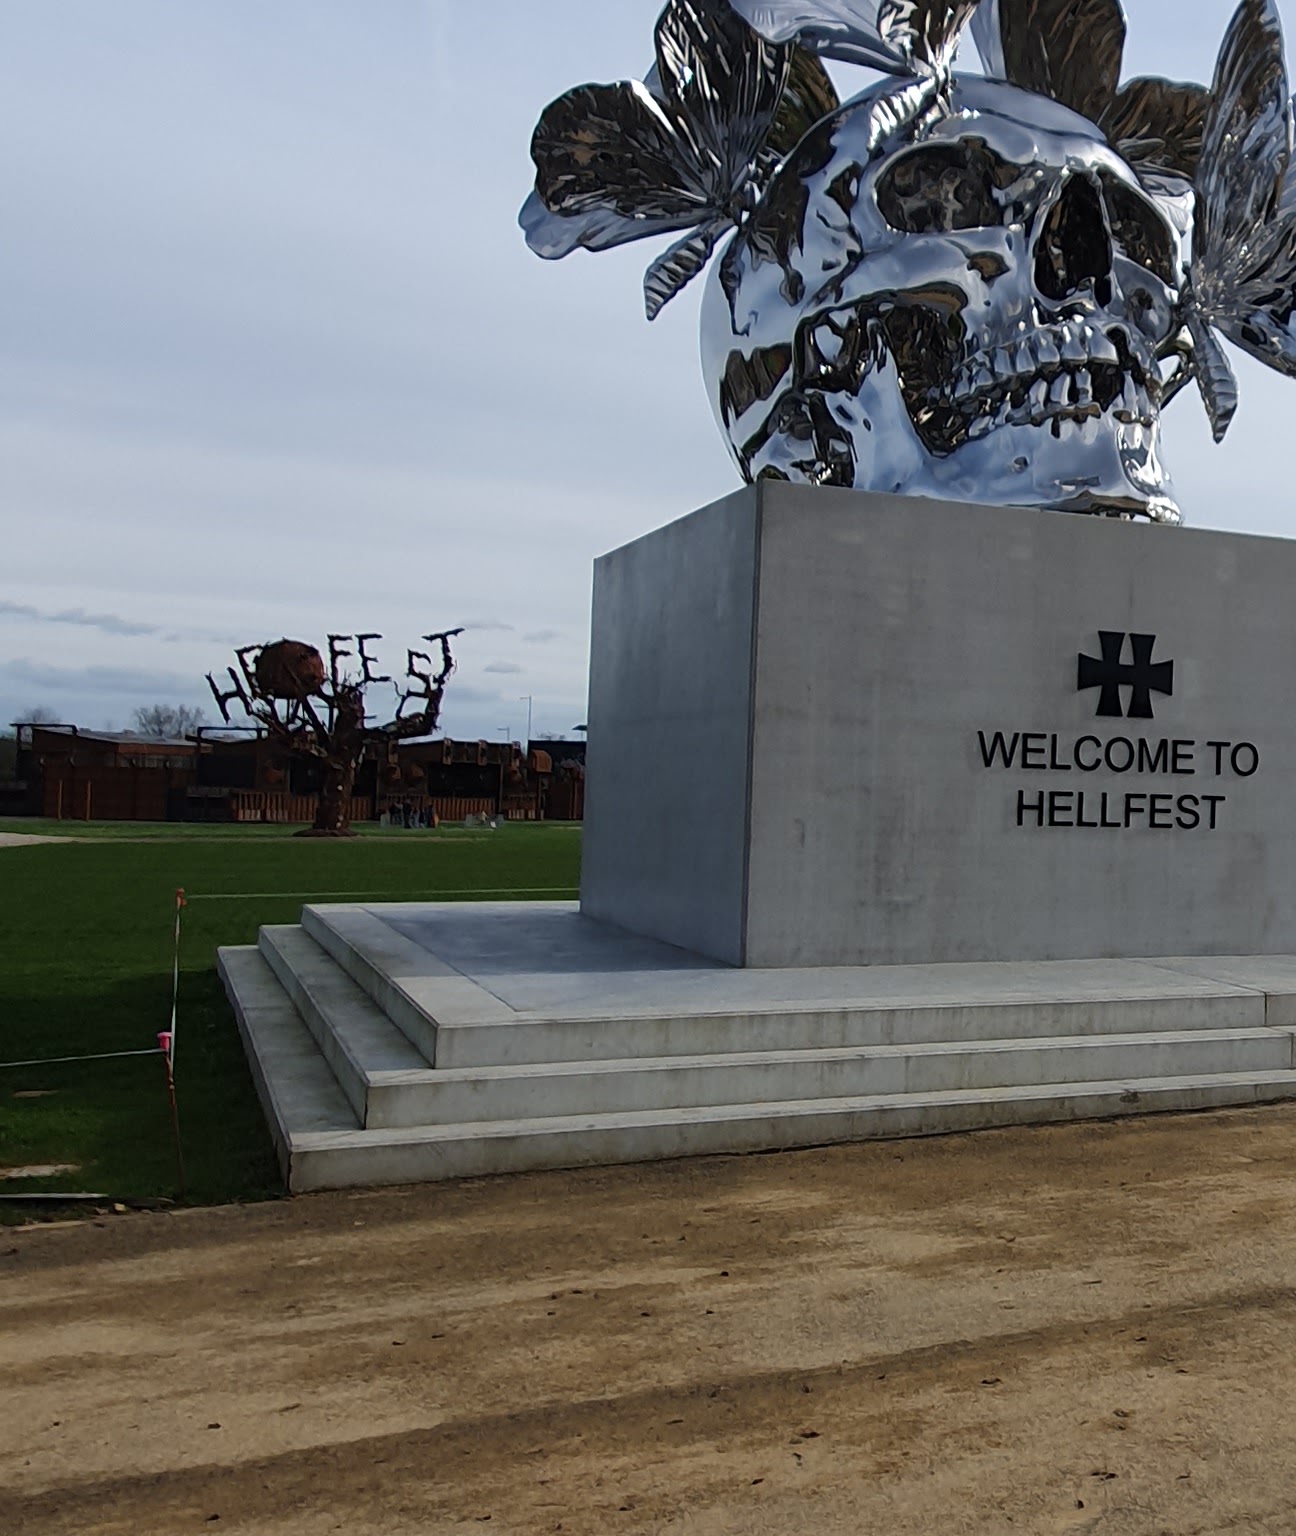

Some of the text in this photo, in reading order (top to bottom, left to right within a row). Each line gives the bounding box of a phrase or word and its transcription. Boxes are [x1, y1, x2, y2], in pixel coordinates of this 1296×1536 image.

[977, 730, 1260, 777] WELCOME TO
[1016, 789, 1226, 830] HELLFEST
